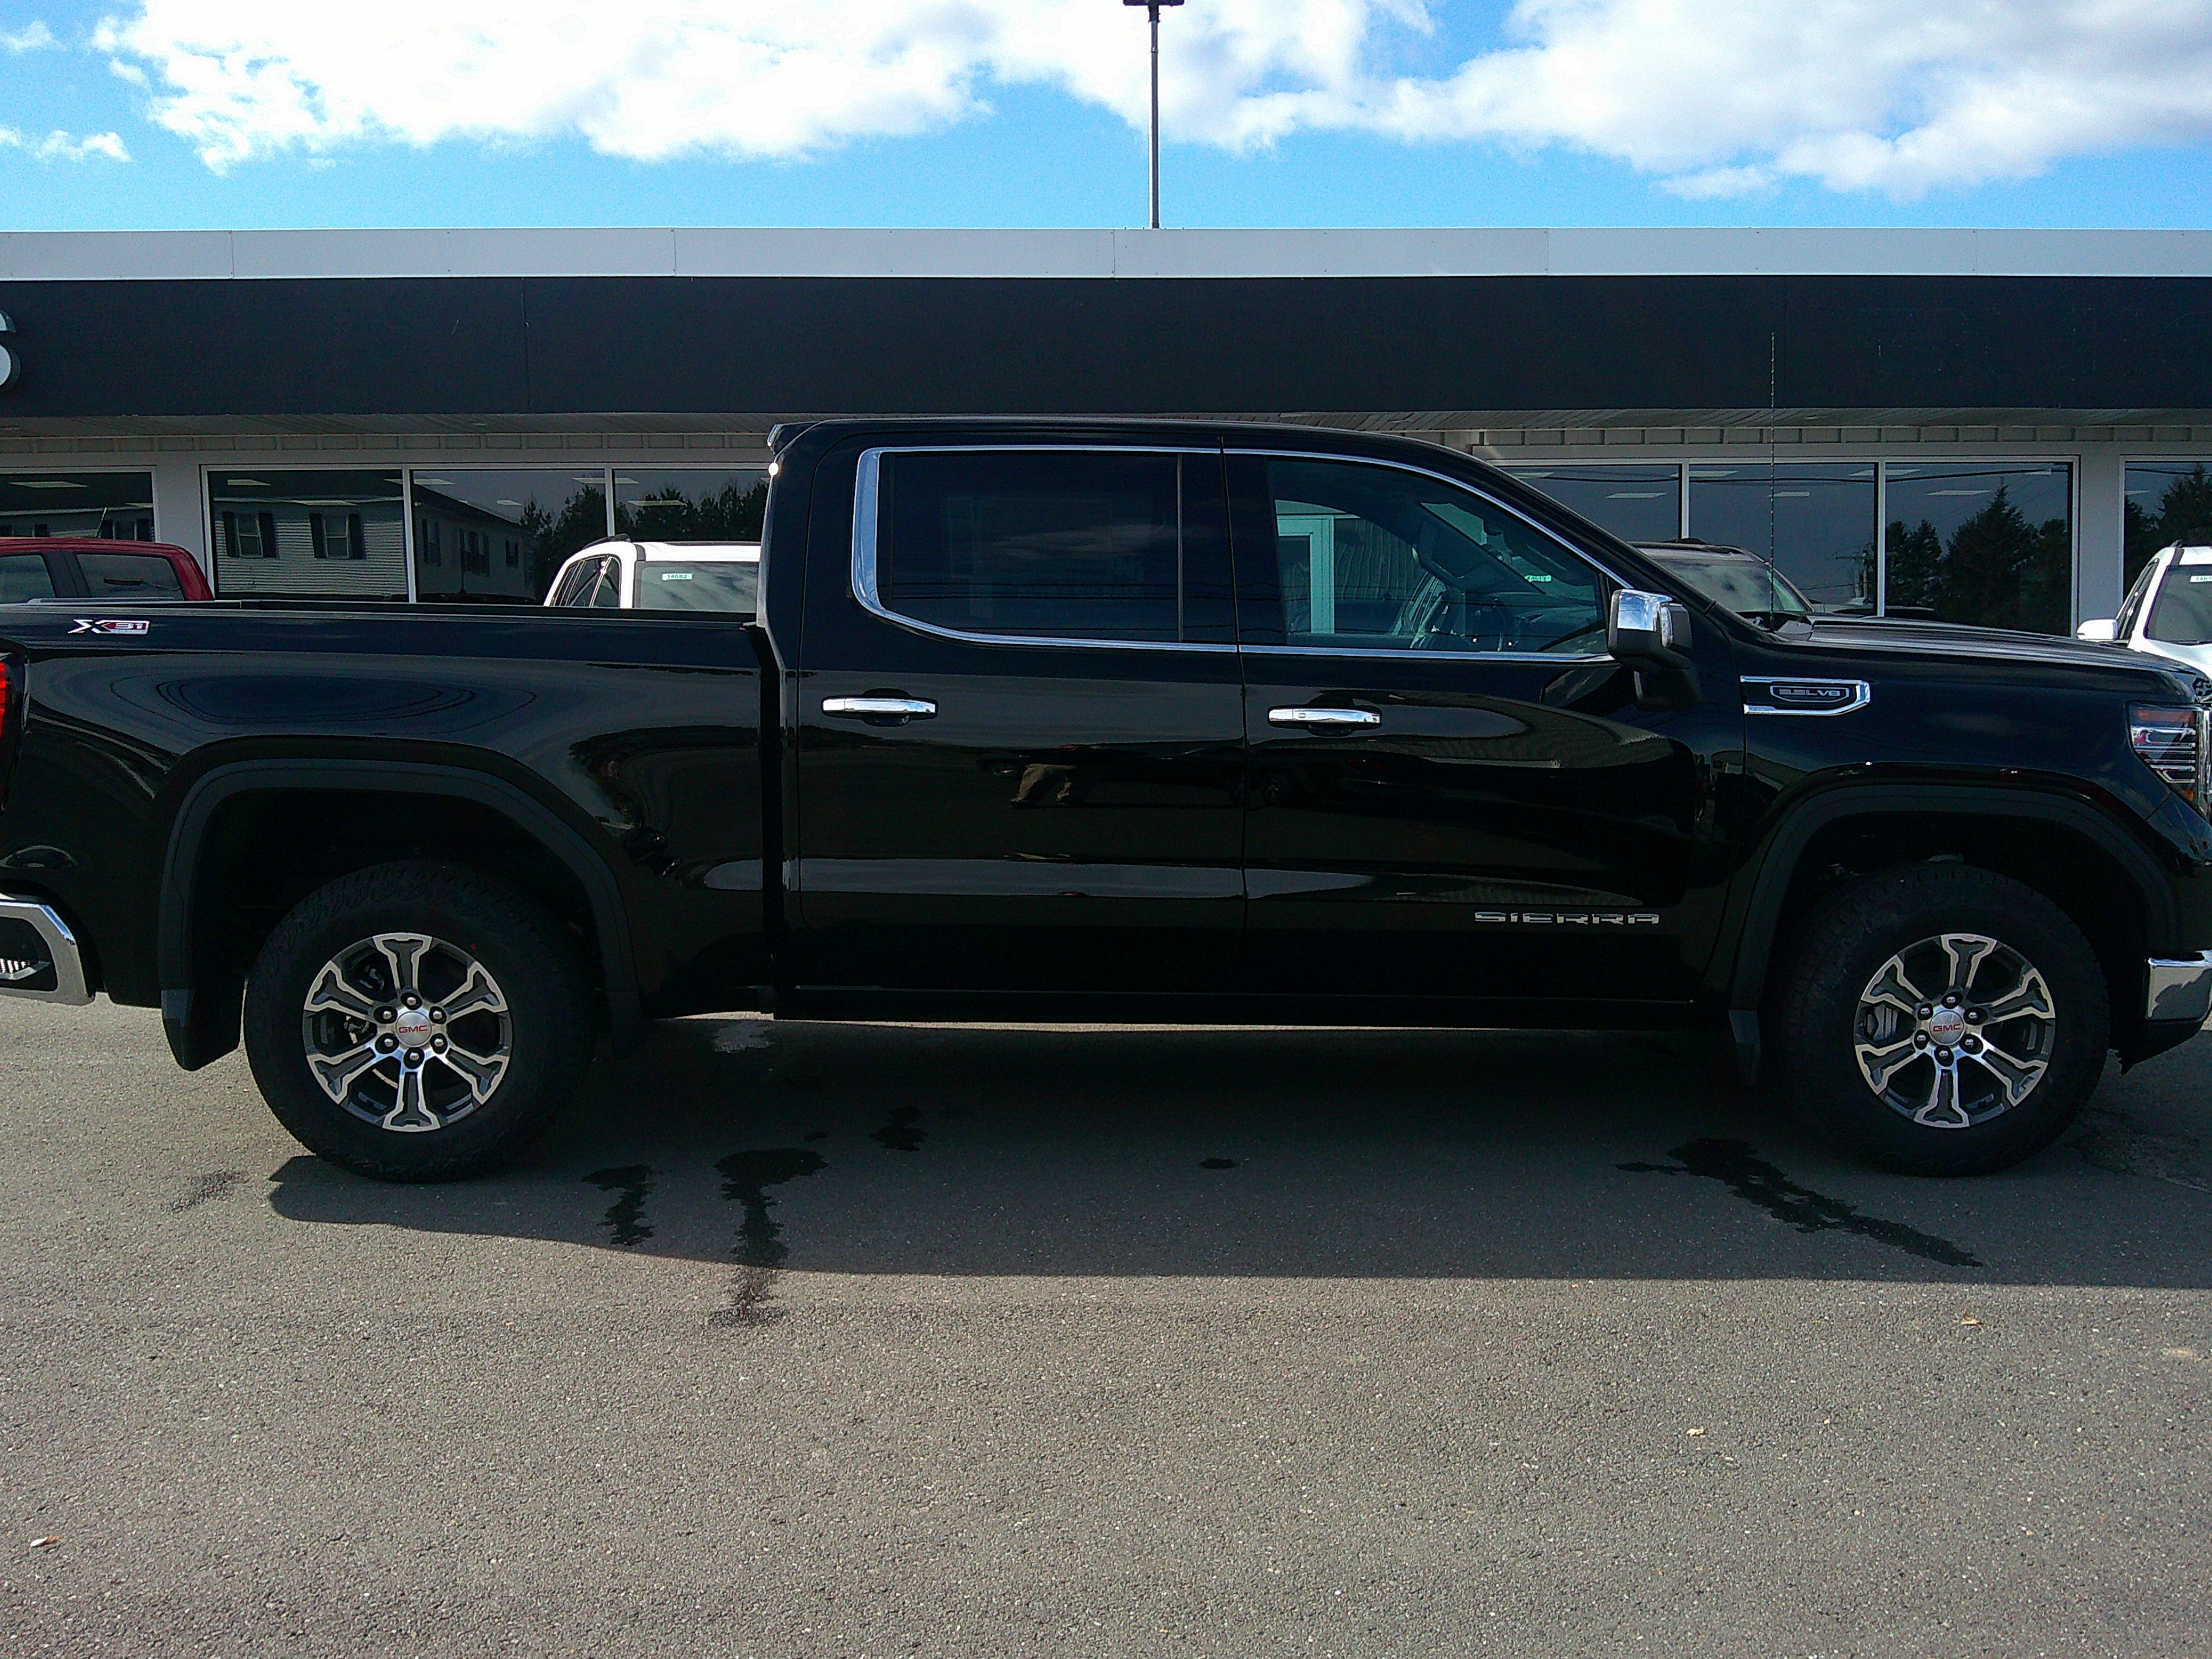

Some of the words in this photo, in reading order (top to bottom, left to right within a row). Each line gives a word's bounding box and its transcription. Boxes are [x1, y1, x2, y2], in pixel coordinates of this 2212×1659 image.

[1474, 912, 1659, 925] SIERRA
[399, 1025, 428, 1034] GMC
[1933, 1024, 1961, 1032] GMC
